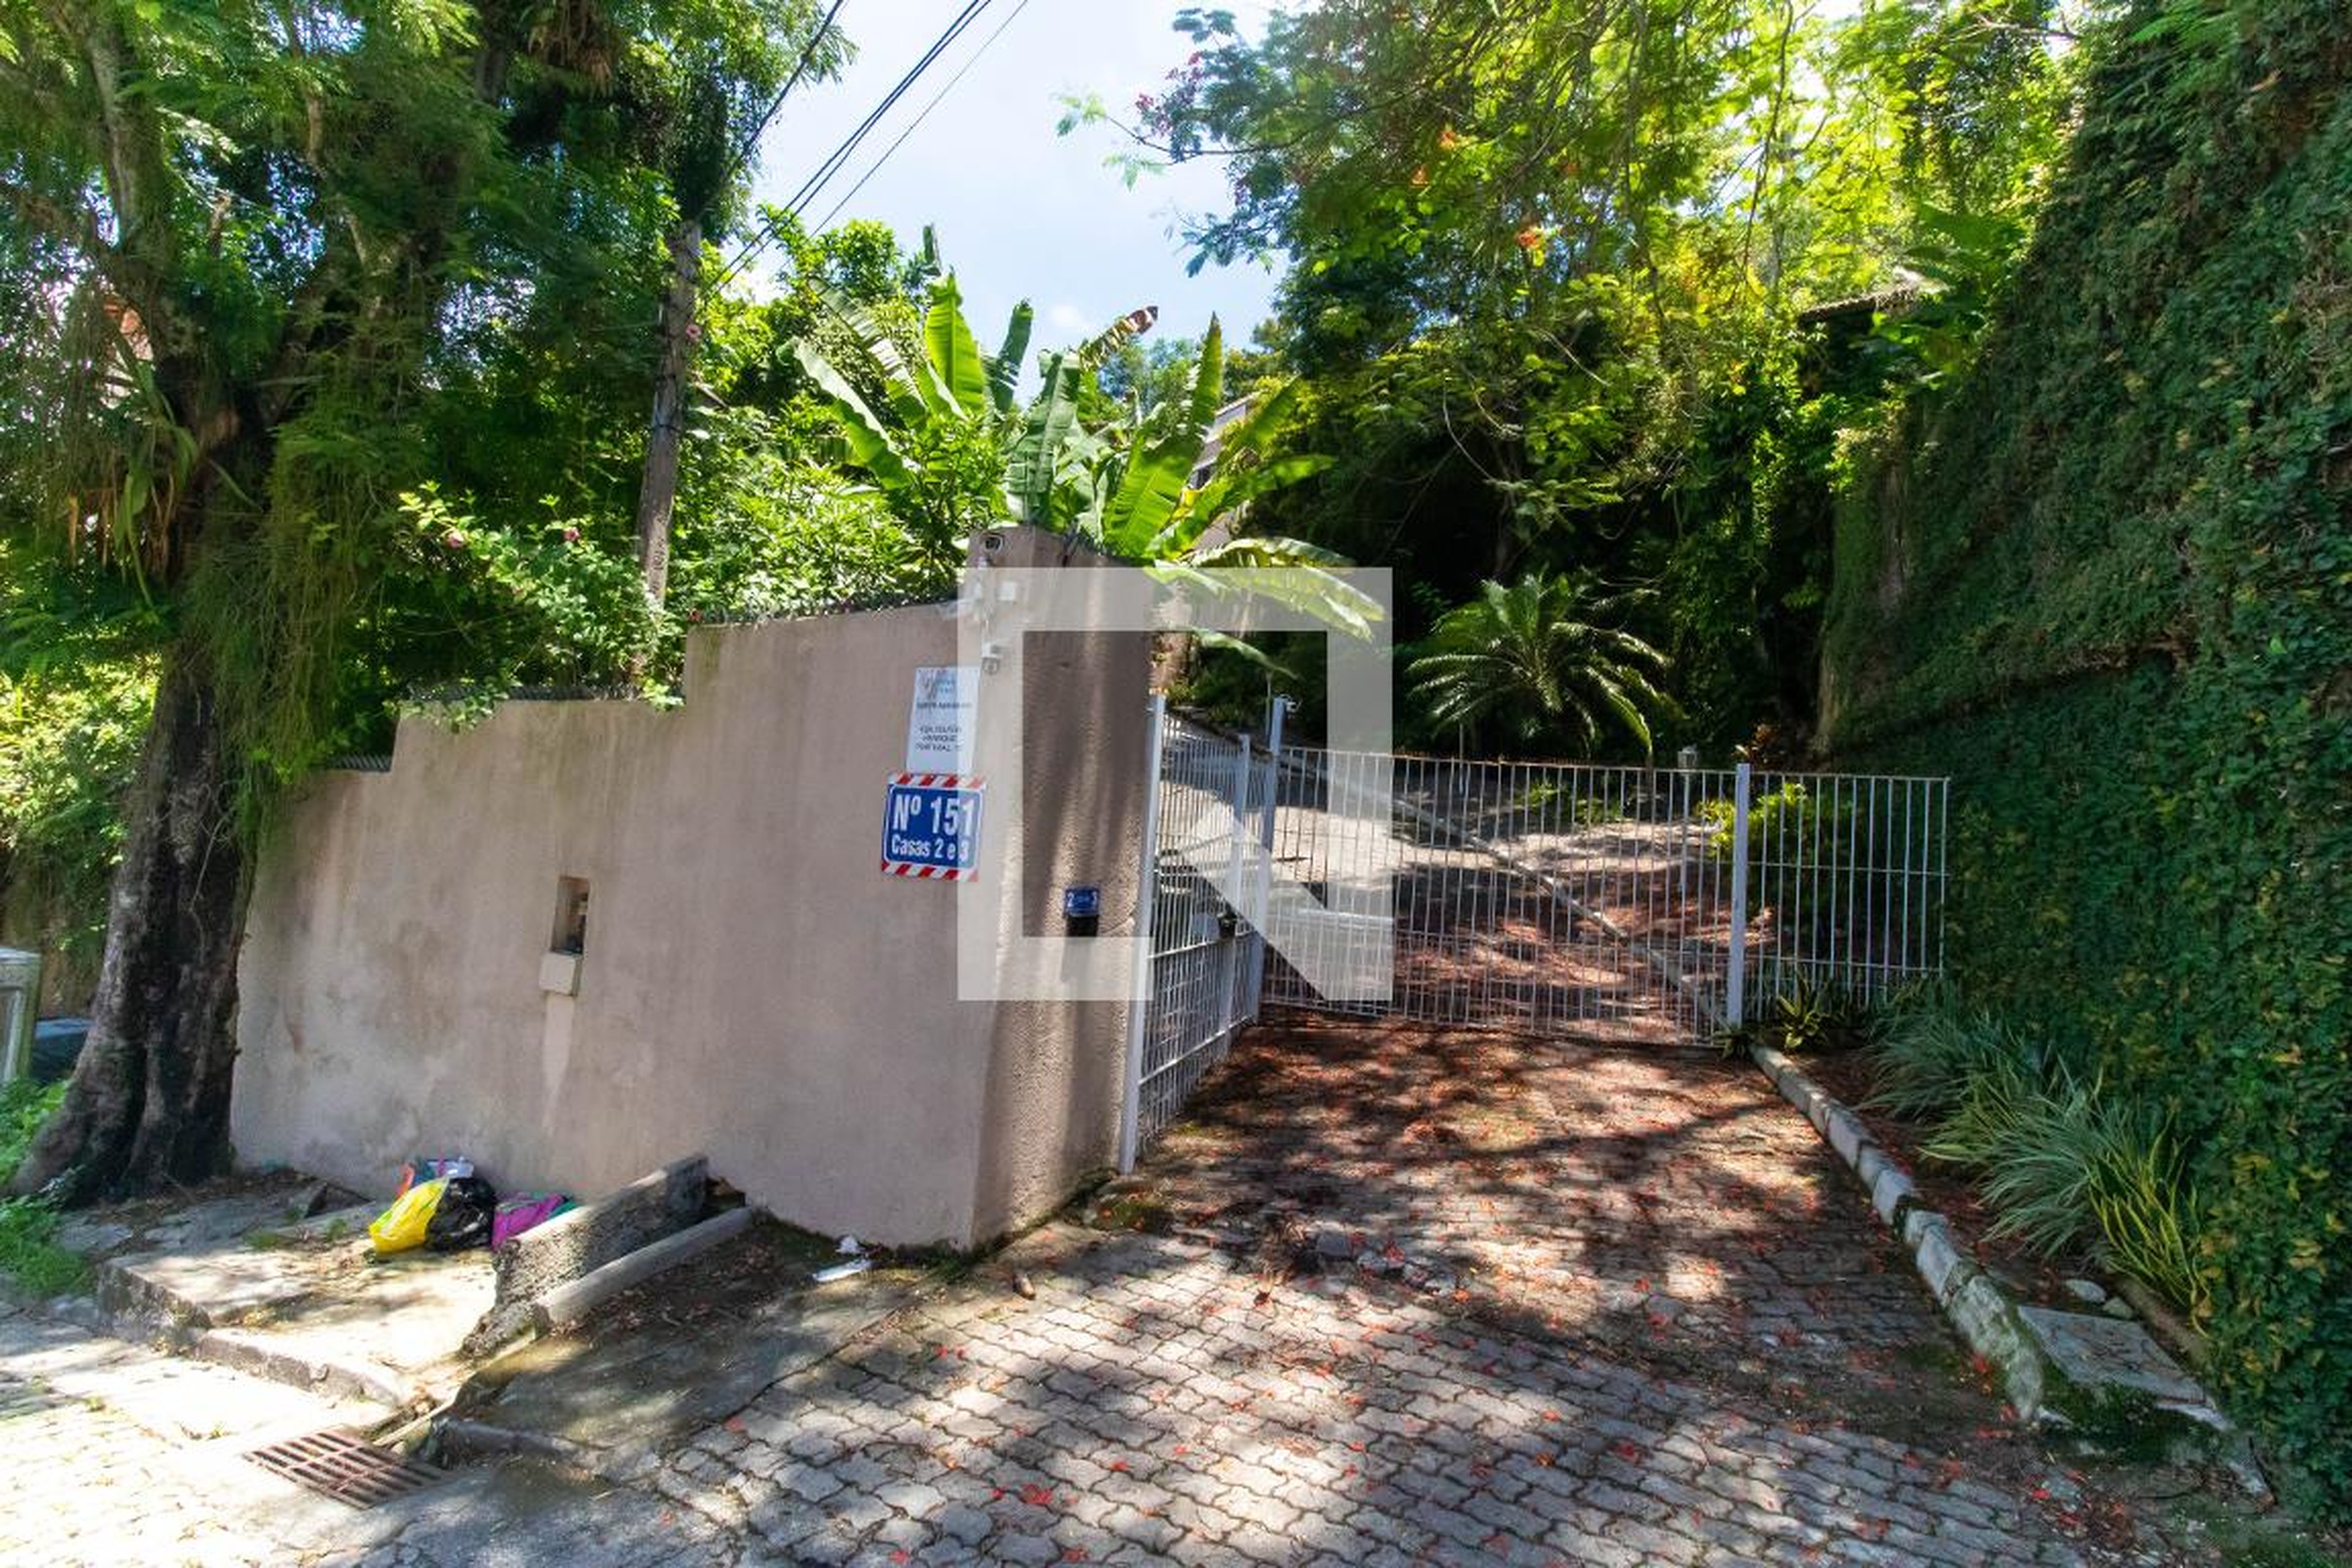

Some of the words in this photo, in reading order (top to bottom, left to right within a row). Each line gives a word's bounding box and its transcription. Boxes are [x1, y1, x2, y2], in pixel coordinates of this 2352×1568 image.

[930, 796, 975, 837] 151
[891, 834, 931, 858] Casas
[933, 838, 944, 859] 2
[947, 842, 956, 861] e
[959, 840, 970, 862] 3
